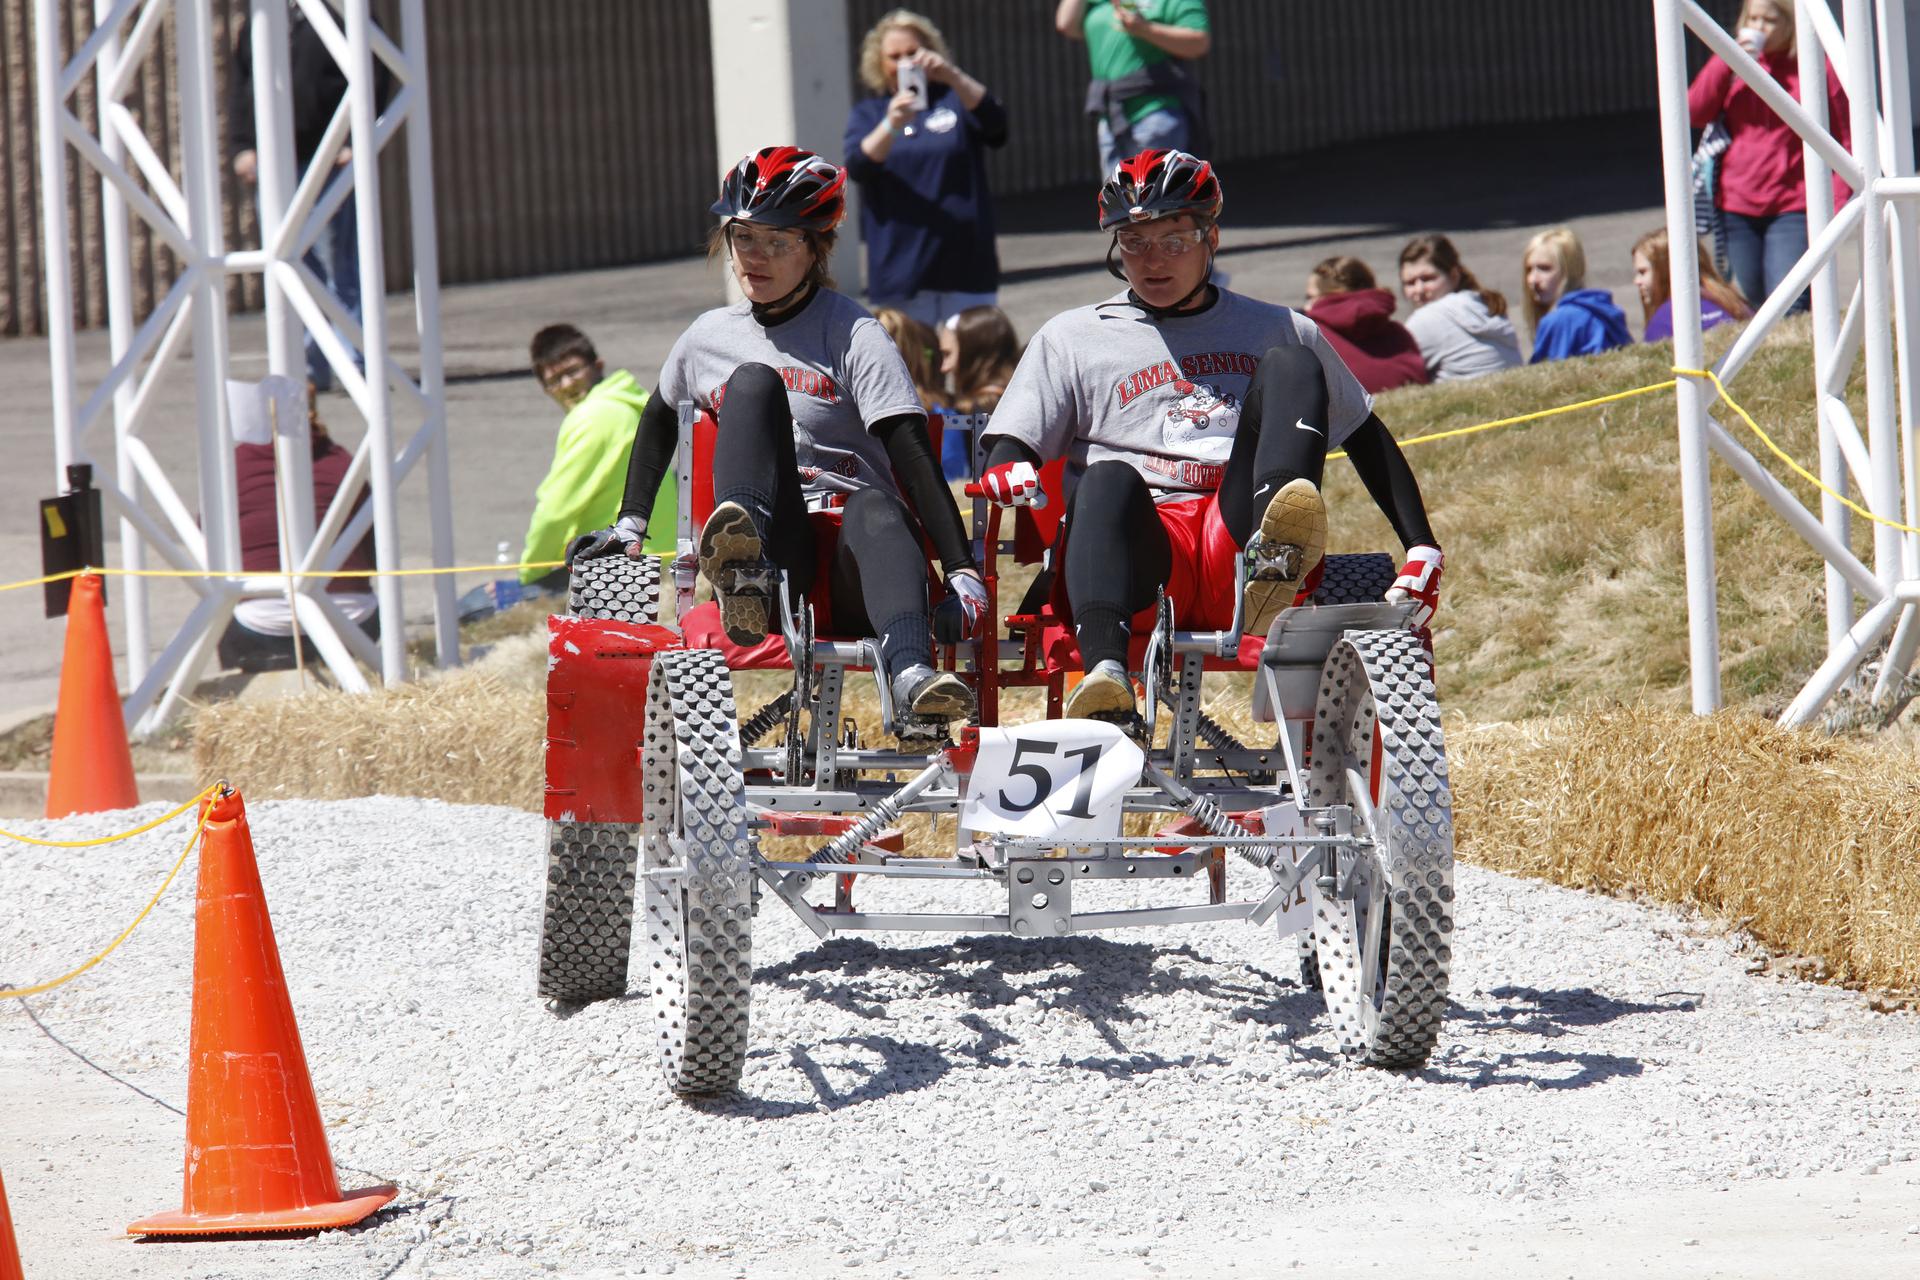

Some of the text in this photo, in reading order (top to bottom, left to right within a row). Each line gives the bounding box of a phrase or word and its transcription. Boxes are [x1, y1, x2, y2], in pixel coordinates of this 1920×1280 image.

[771, 366, 840, 405] NIOR
[1116, 352, 1258, 410] LIMA SENIO
[1181, 460, 1224, 487] ROVER
[998, 738, 1103, 820] 51
